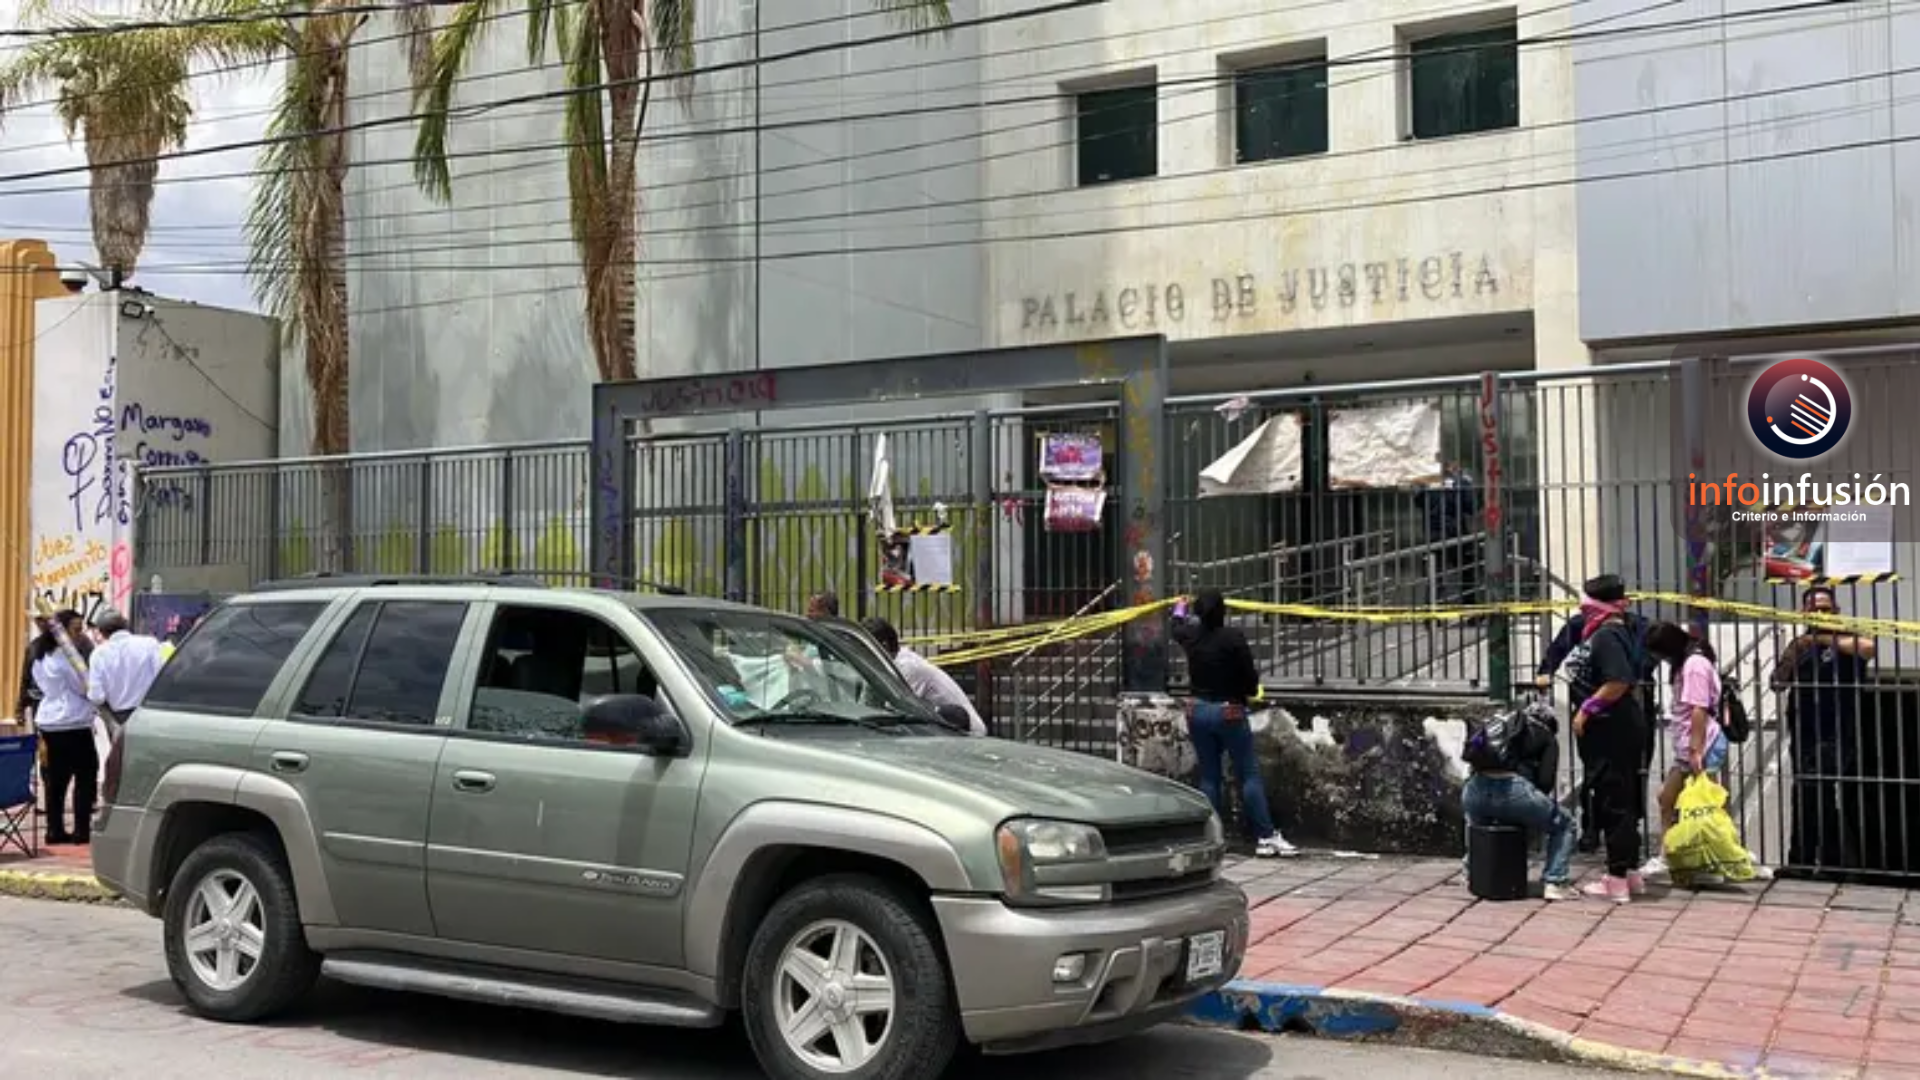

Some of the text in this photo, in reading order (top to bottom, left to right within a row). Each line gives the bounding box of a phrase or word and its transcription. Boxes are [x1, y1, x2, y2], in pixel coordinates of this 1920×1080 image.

[1020, 251, 1499, 330] PALACIO DE JUSTICIA
